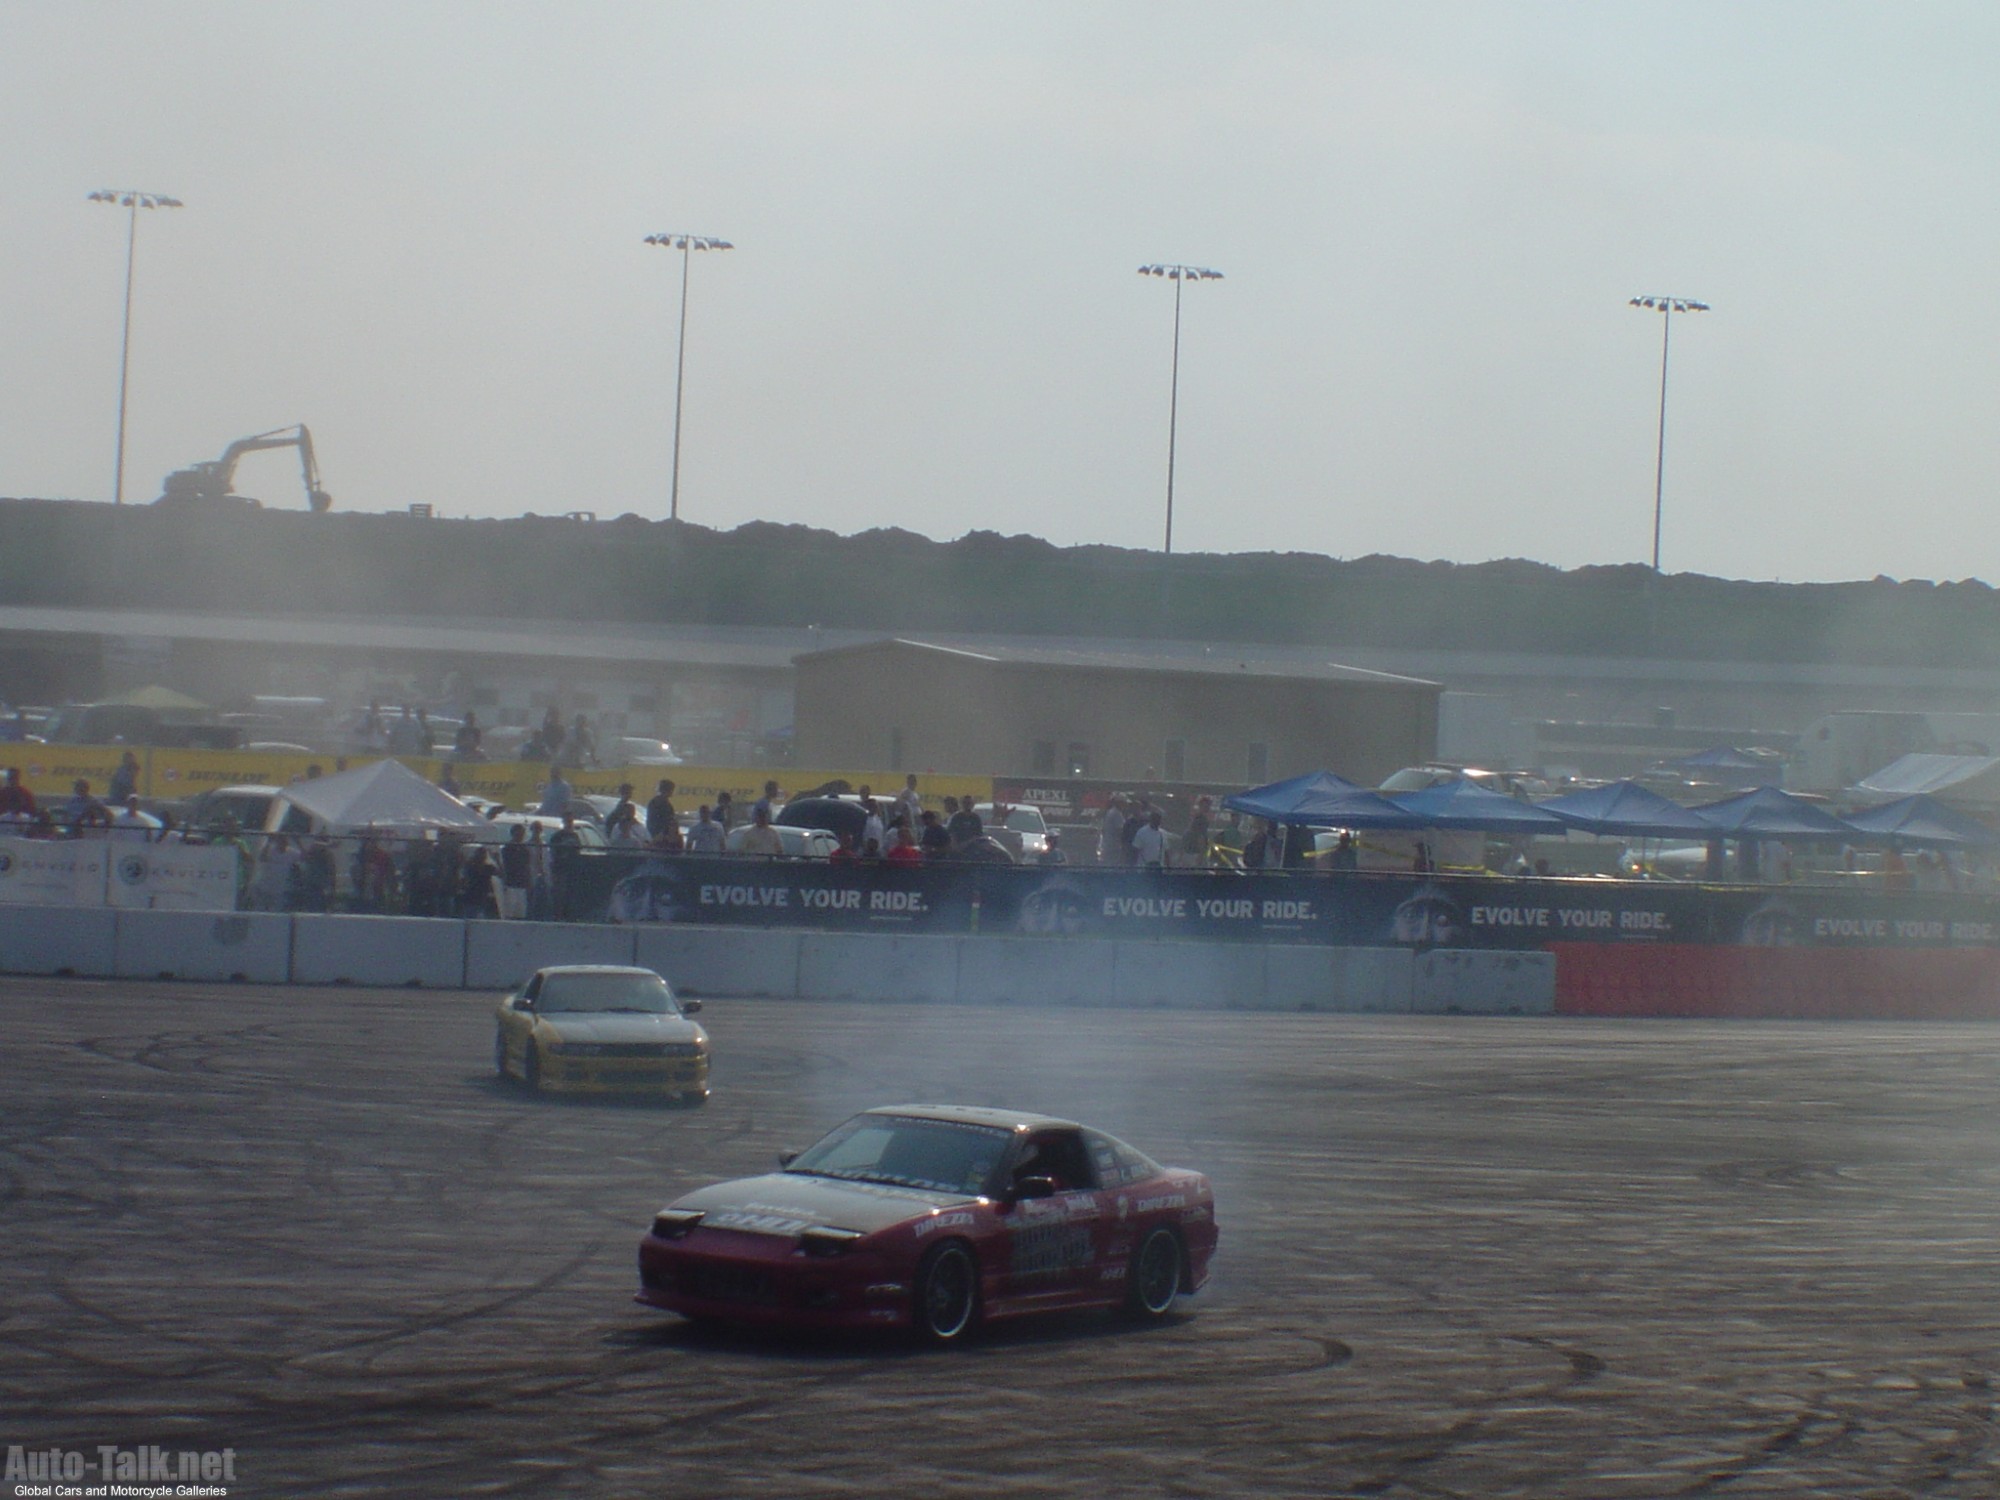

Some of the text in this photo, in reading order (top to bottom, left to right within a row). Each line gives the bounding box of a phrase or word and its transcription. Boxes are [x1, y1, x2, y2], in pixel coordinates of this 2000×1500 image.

[52, 765, 115, 778] DUNLO
[187, 770, 271, 785] DUNLOP
[700, 885, 928, 911] EVOLVE YOUR RIDE.
[1102, 896, 1316, 921] EVOLVE YOUR RIDE.
[1470, 906, 1670, 930] EVOLVE YOUR RIDE.
[1814, 918, 1887, 937] EVOLVE
[1894, 919, 1945, 939] YOUR
